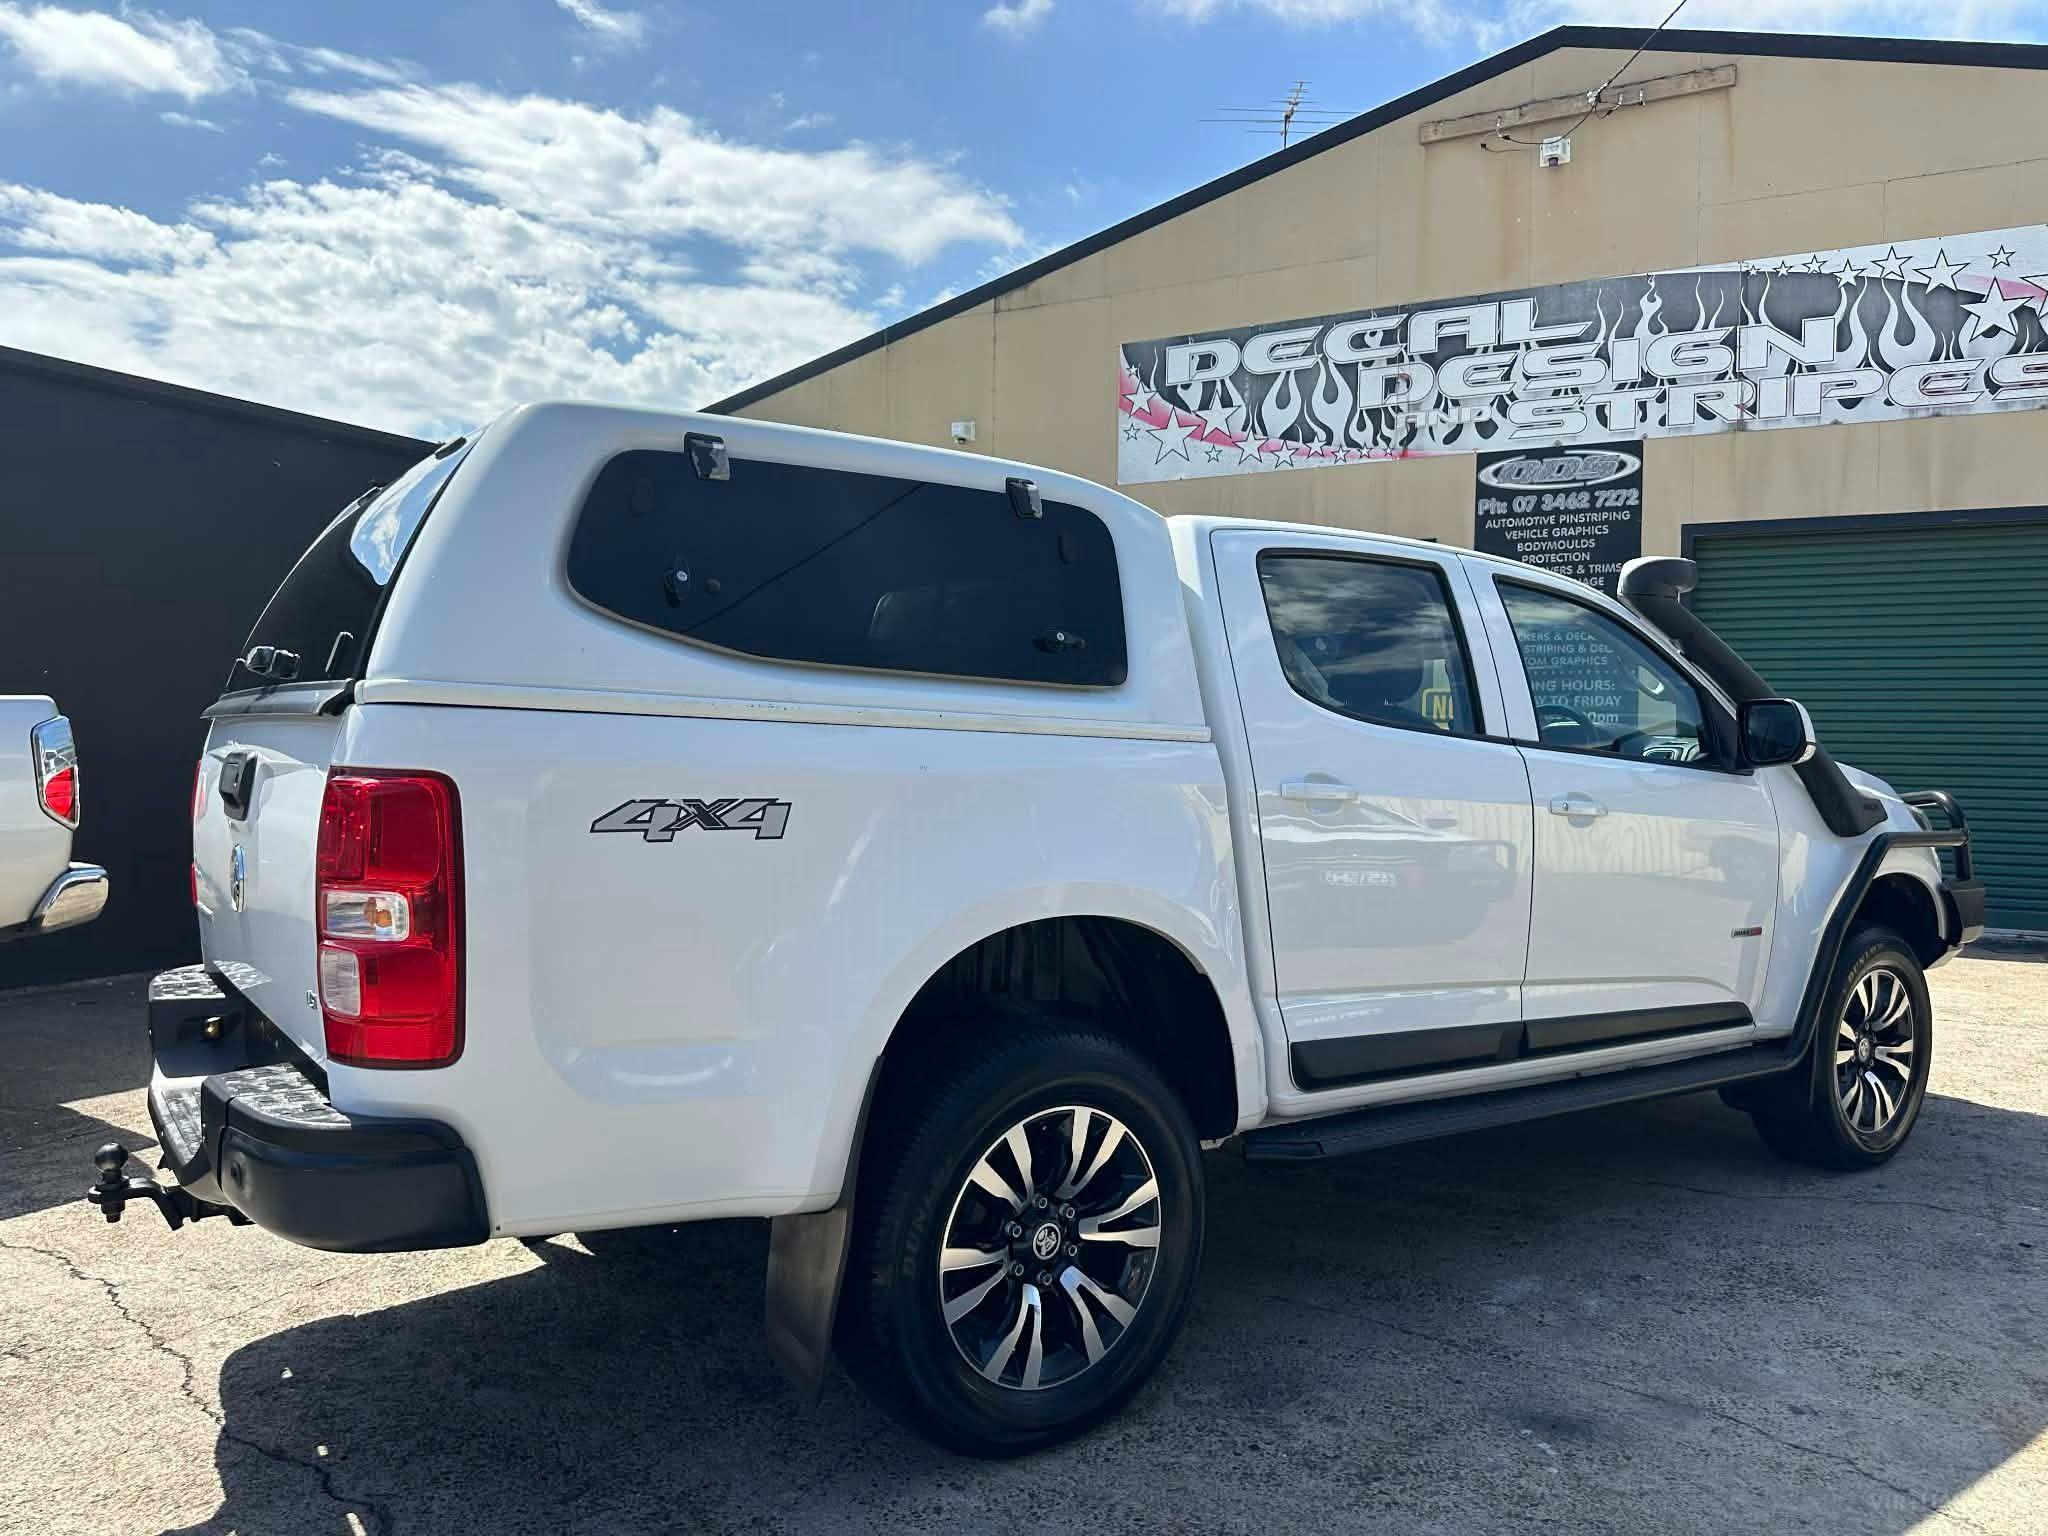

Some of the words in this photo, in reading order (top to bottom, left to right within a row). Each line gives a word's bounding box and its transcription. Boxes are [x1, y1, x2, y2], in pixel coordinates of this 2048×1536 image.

[1165, 298, 1593, 387] DECAL
[1357, 315, 1837, 410] DESIGN
[1507, 352, 2048, 440] STRIPES
[1512, 495, 1538, 514] 07
[1540, 491, 1591, 512] 3462
[1594, 487, 1640, 508] 7272
[1485, 515, 1556, 529] AUTOMOTIVE
[1559, 510, 1631, 524] PINSTRIPING
[1505, 529, 1549, 540] VEHICLE
[1552, 525, 1609, 537] GRAPHICS
[1517, 538, 1596, 552] BODYMOULDS
[1521, 552, 1590, 564] PROTECTION
[1577, 564, 1585, 574] &
[1588, 562, 1622, 574] TRIMS
[1551, 655, 1608, 666] GRAPHICS
[1551, 695, 1569, 705] TO
[1574, 695, 1622, 706] FRIDAY
